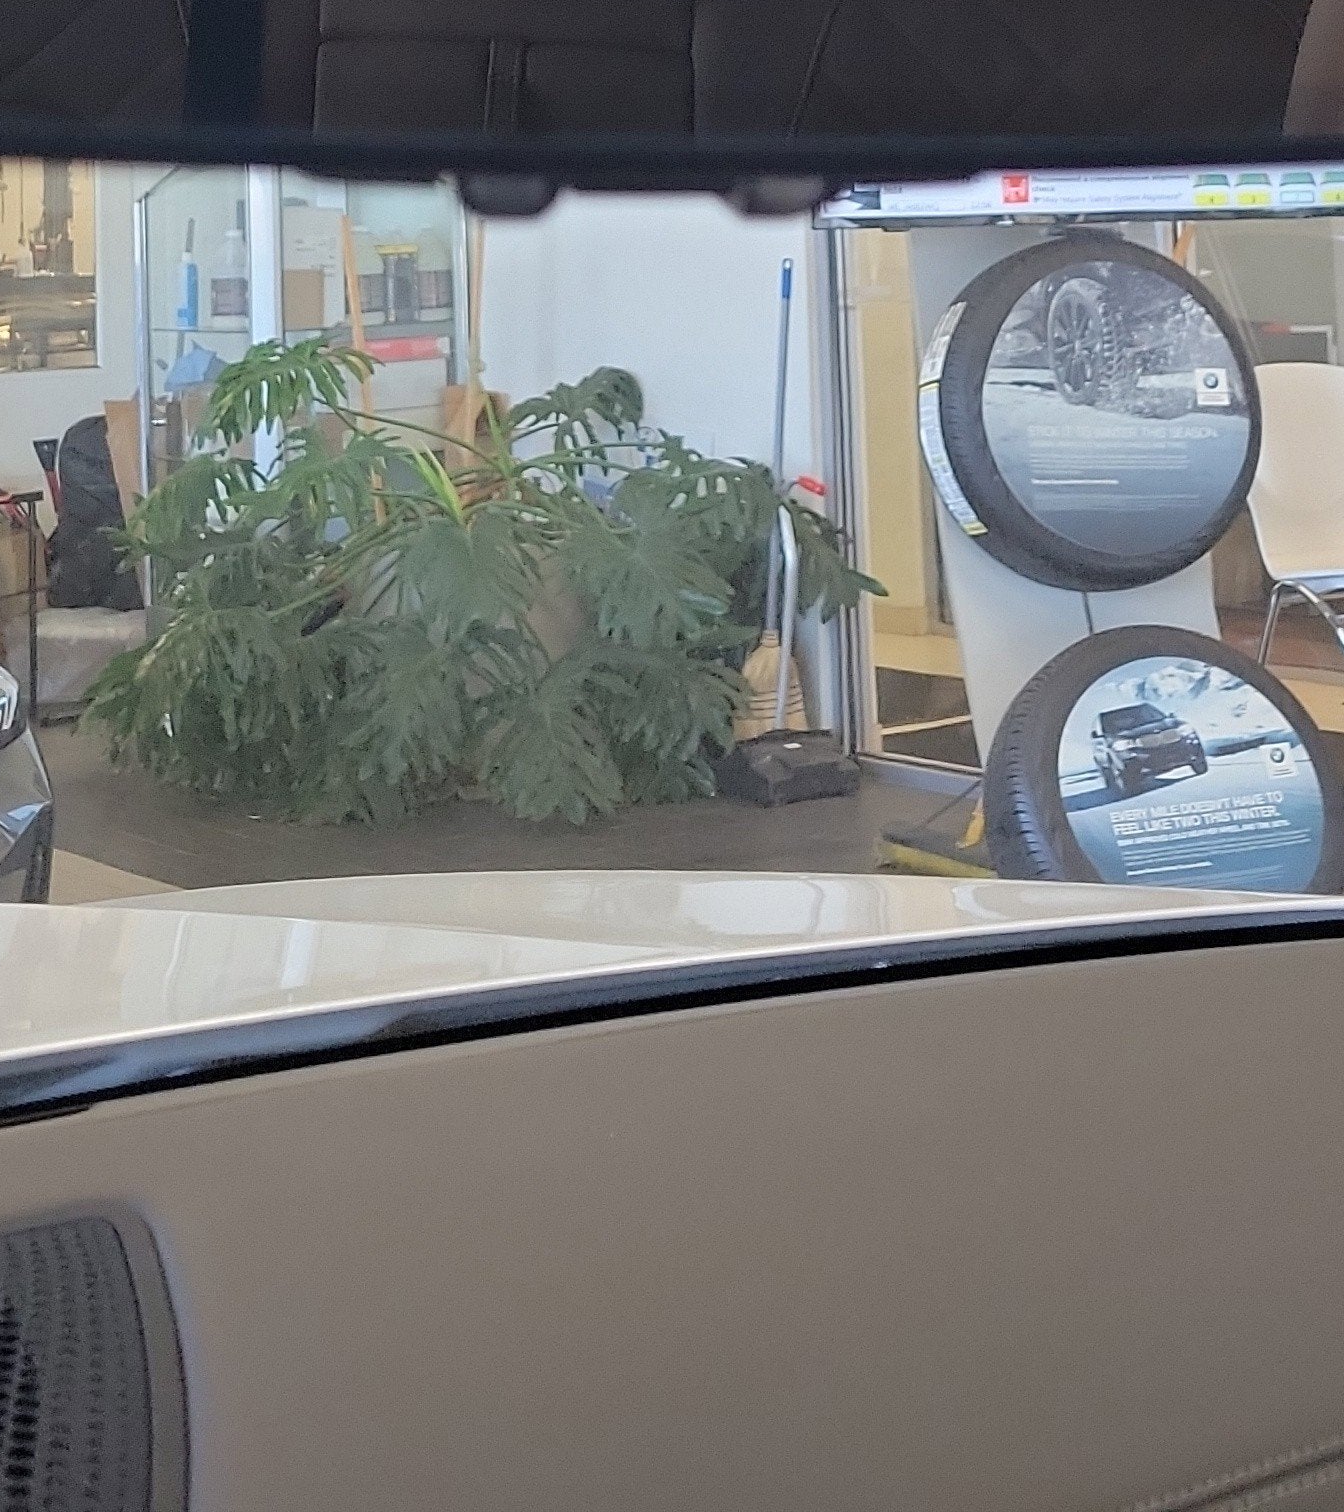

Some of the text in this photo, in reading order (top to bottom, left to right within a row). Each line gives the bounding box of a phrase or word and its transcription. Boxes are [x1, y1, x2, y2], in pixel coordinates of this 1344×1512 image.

[1110, 808, 1151, 823] EVERY
[1151, 804, 1179, 819] MILE
[1233, 793, 1265, 808] HAVE
[1266, 790, 1285, 804] TO
[1113, 822, 1144, 836] FEEL
[1145, 818, 1173, 833] LIKE
[1174, 814, 1201, 829] TWO
[1201, 810, 1231, 825] THIS
